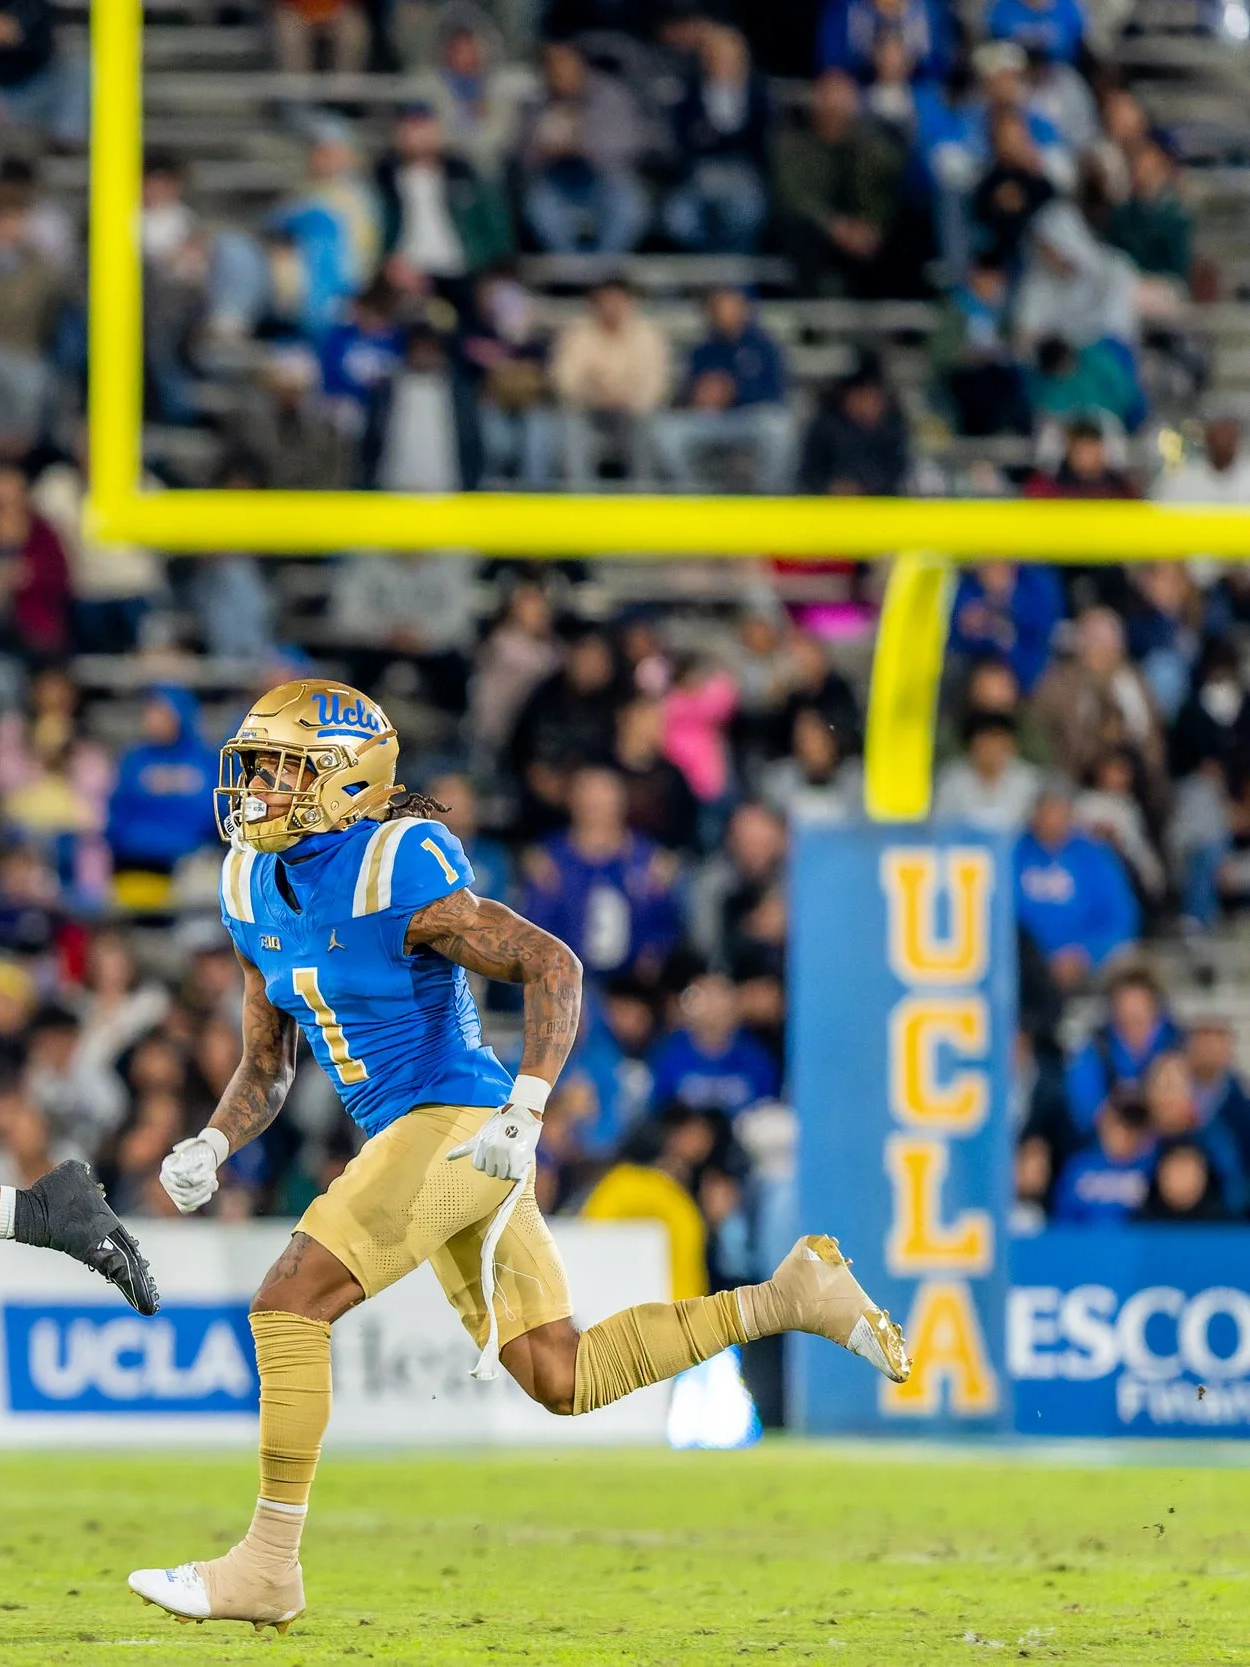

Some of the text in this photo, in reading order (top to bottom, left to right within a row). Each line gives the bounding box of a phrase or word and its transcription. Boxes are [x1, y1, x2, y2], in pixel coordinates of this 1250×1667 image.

[420, 837, 459, 886] 1
[291, 966, 370, 1087] 1
[879, 845, 1000, 1417] UCLA
[28, 1316, 249, 1400] UCLA
